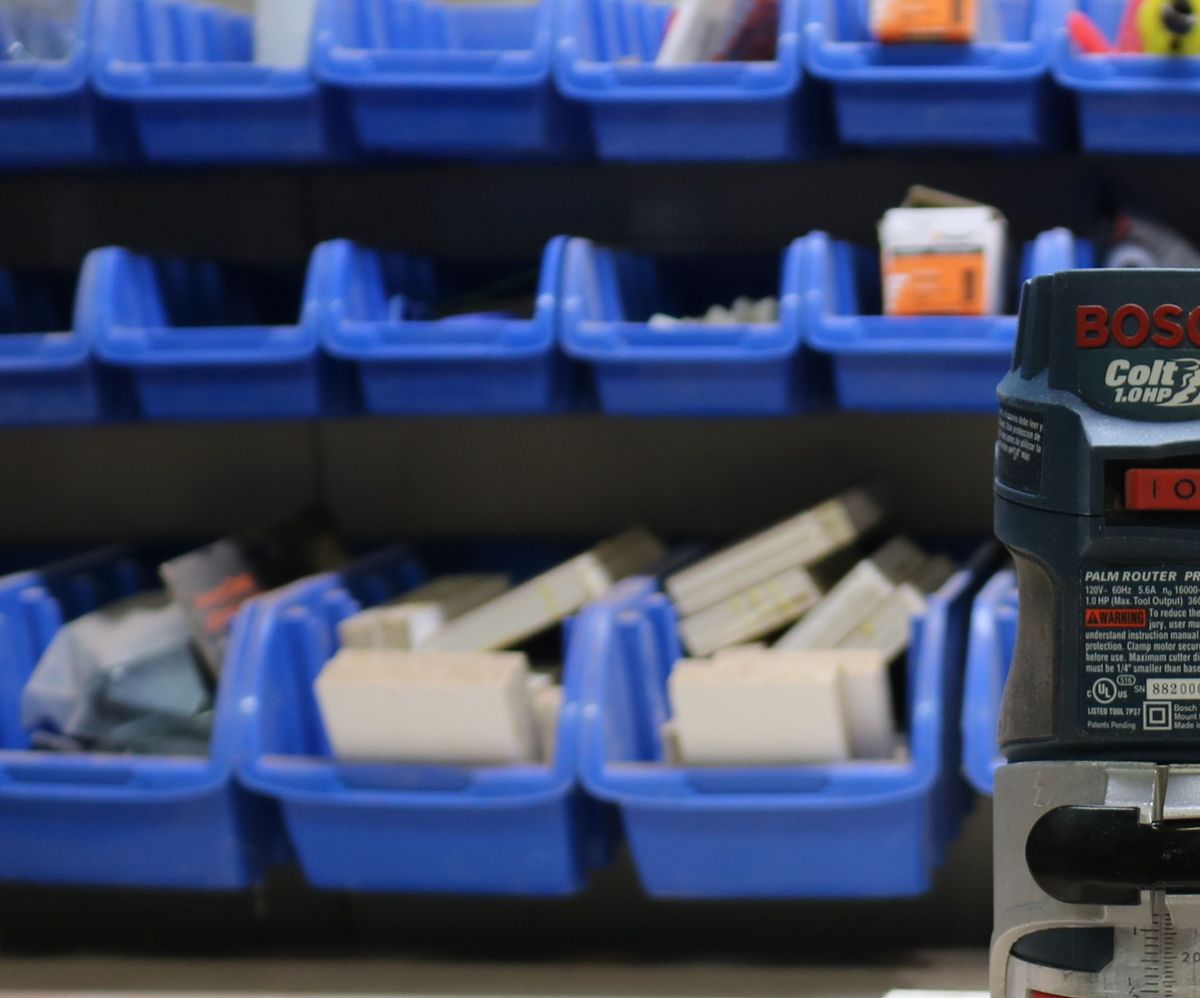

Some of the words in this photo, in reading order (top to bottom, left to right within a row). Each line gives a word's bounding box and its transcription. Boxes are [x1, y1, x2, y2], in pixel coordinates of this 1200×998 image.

[1105, 359, 1178, 387] Colt
[1085, 571, 1119, 582] PALM
[1122, 571, 1177, 582] ROUTER
[1112, 585, 1132, 594] 60Hz
[1138, 585, 1156, 594] 5.6A
[1098, 596, 1109, 605] HP
[1111, 596, 1132, 607] (Max.
[1133, 596, 1151, 605] Tool
[1152, 596, 1184, 607] Output)
[1149, 607, 1159, 617] To
[1161, 608, 1187, 617] reduce
[1188, 607, 1200, 617] the
[1100, 611, 1144, 625] WARNING
[1085, 630, 1126, 639] understand
[1127, 630, 1169, 639] instruction
[1085, 642, 1124, 652] protection.
[1127, 641, 1152, 652] Clamp
[1153, 642, 1176, 651] motor
[1085, 652, 1109, 661] before
[1110, 653, 1127, 661] use.
[1129, 652, 1167, 661] Maximum
[1168, 653, 1191, 661] cutter
[1085, 663, 1103, 672] must
[1105, 663, 1115, 672] be
[1133, 663, 1163, 672] smaller
[1164, 663, 1182, 672] than
[1087, 707, 1108, 715] LISTED
[1109, 707, 1124, 715] TOOL
[1174, 703, 1198, 711] Bosch
[1174, 712, 1198, 720] Mount
[1087, 720, 1110, 729] Patents
[1111, 720, 1136, 730] Pending
[1174, 721, 1195, 729] Made
